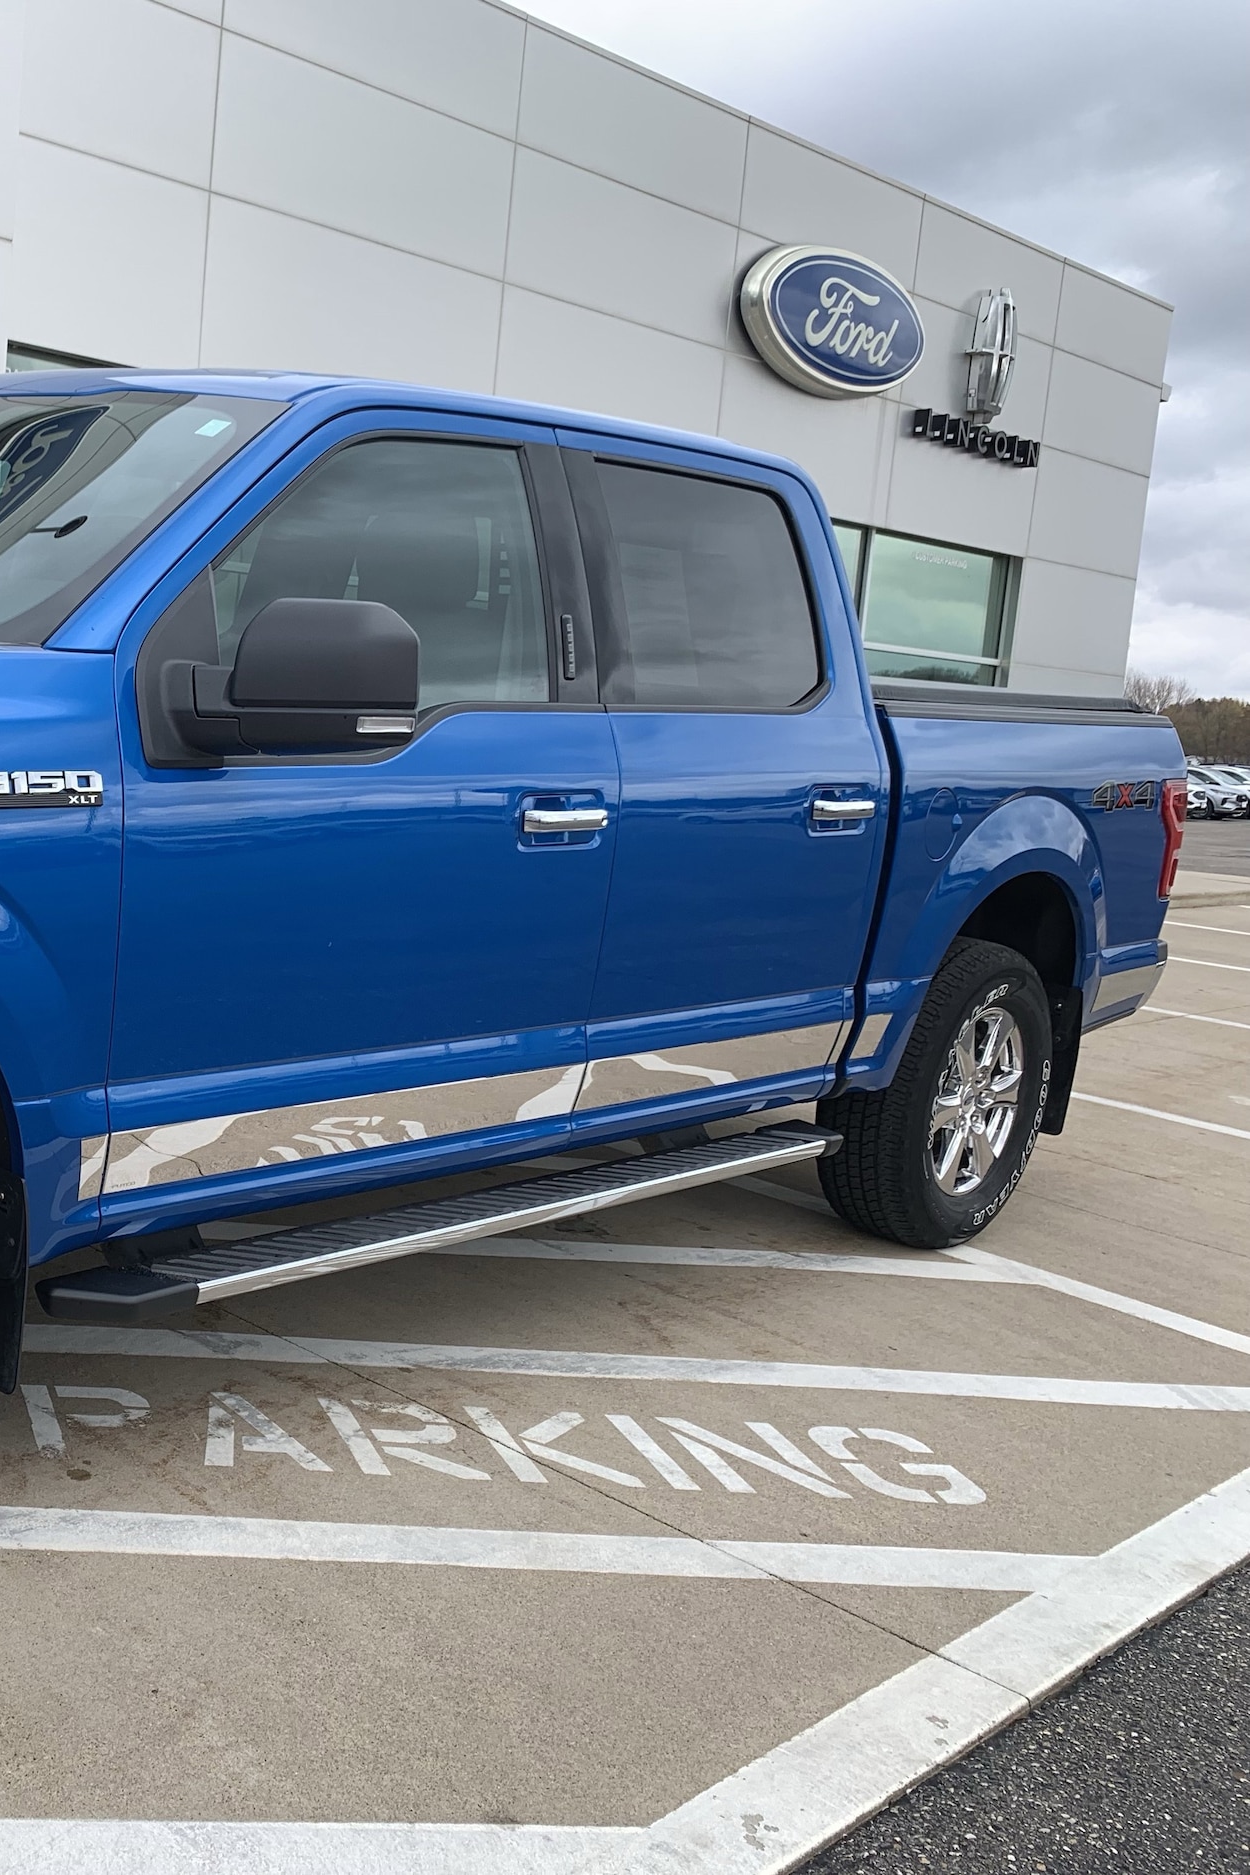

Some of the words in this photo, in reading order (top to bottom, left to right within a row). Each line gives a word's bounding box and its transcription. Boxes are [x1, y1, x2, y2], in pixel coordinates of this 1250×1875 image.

[805, 277, 899, 367] Ford
[913, 408, 1041, 468] LINCOLN
[68, 794, 98, 804] XLT
[972, 1059, 1051, 1226] GOODYEAR
[20, 1384, 987, 1506] PARKING
